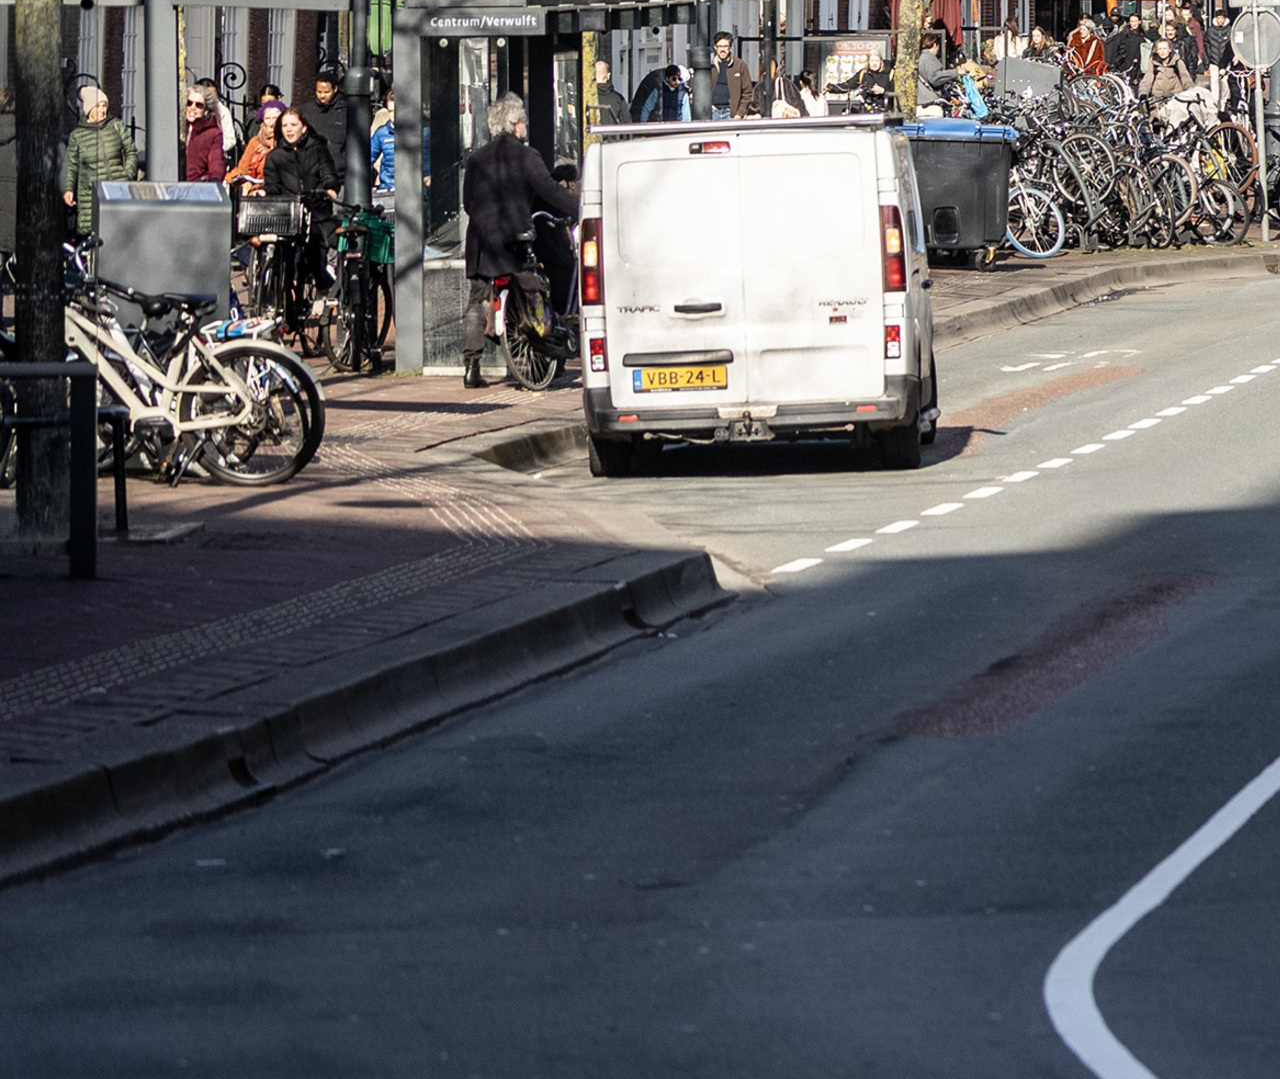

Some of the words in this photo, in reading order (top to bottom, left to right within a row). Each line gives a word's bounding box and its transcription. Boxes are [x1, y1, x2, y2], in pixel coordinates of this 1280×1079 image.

[430, 15, 537, 28] Centrum/Verwulft
[818, 297, 869, 307] RENAULT
[616, 305, 661, 314] TRAFIC
[646, 370, 721, 386] VBB-24-L
